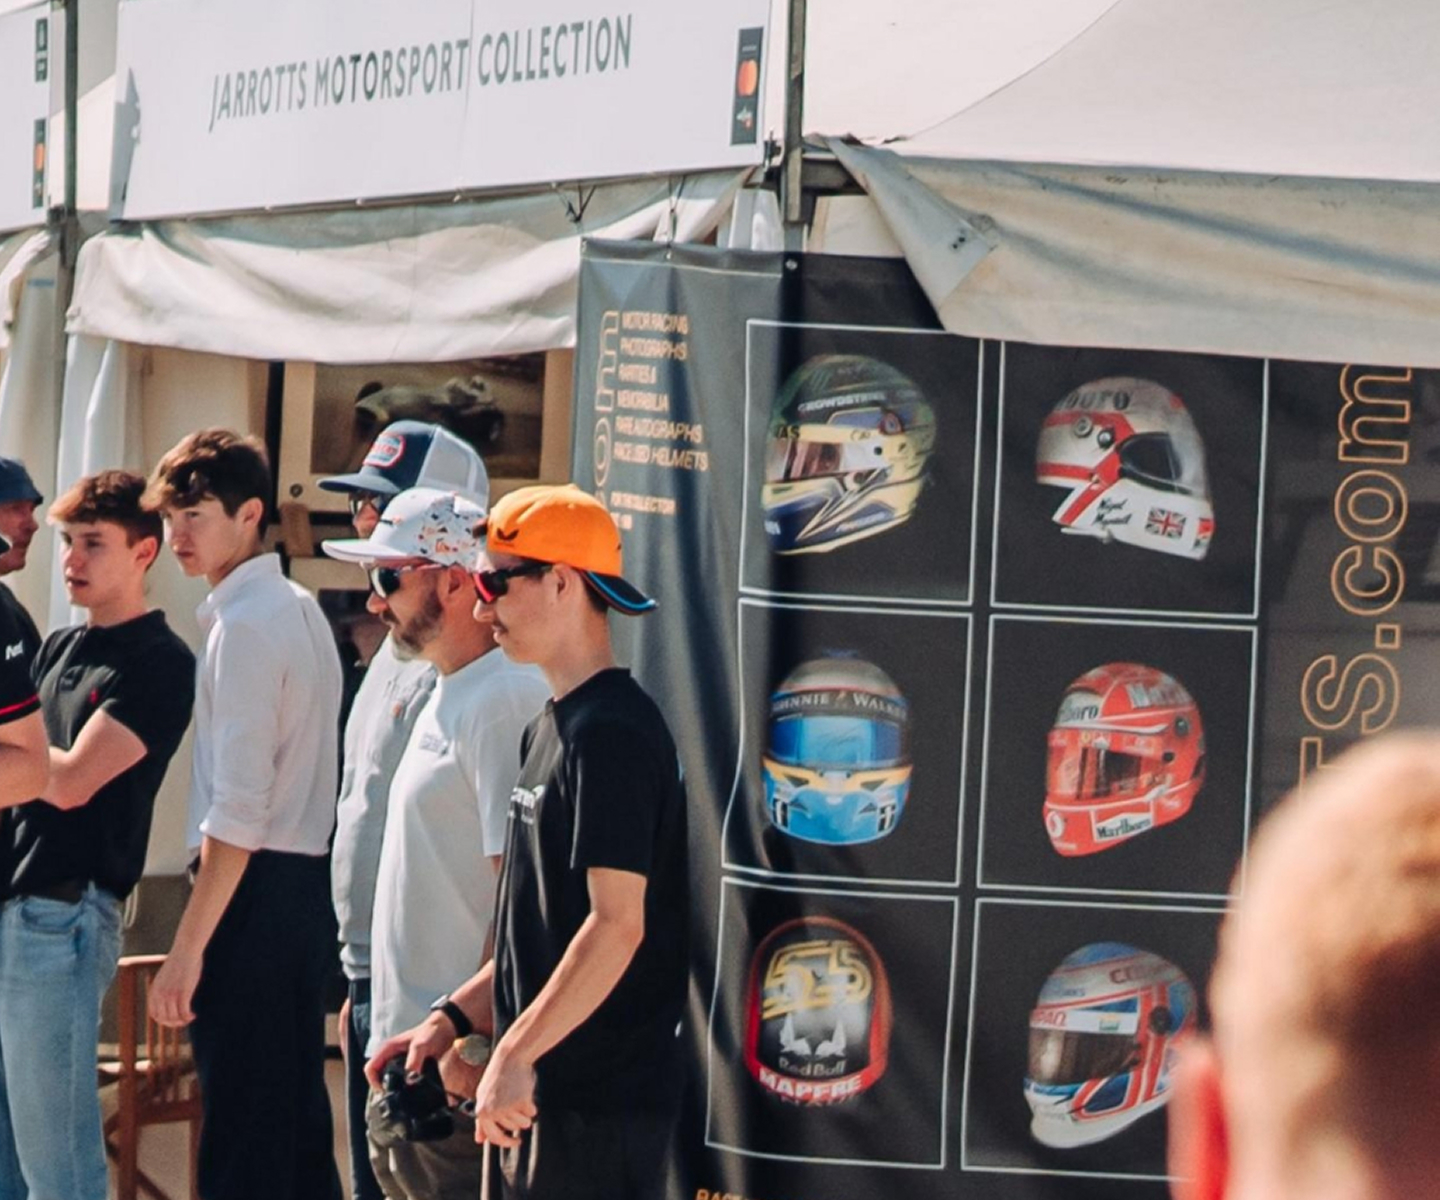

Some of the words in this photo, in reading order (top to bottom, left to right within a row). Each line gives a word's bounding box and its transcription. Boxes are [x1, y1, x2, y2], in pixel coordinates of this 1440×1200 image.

[209, 61, 307, 133] JARROTTS
[313, 38, 469, 107] MOTORSPORT
[479, 14, 632, 86] COLLECTION
[651, 444, 709, 471] HELMETS
[759, 1066, 861, 1098] MAPFRE
